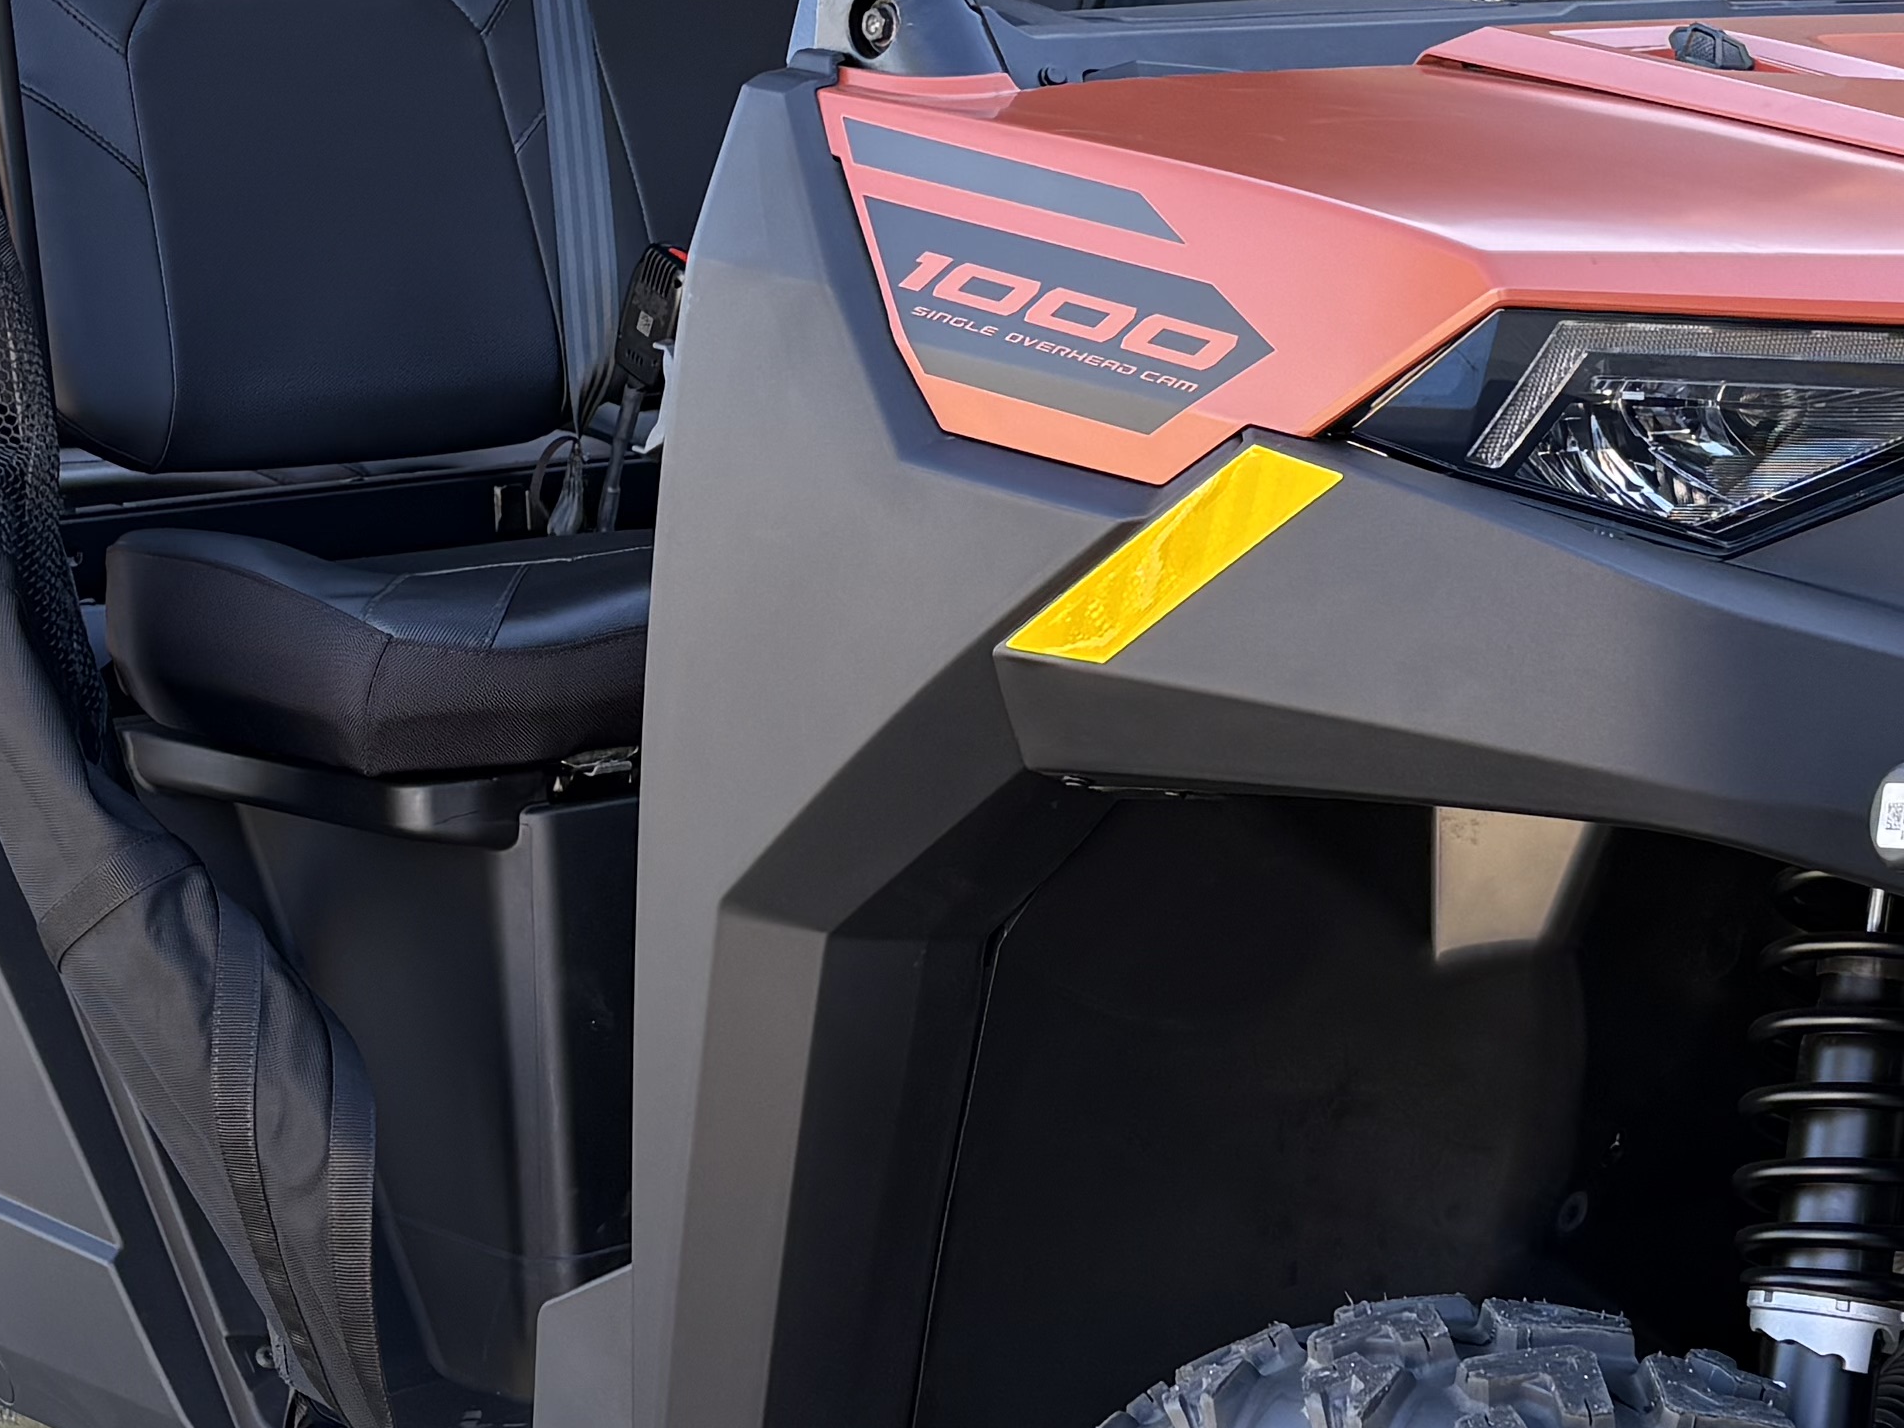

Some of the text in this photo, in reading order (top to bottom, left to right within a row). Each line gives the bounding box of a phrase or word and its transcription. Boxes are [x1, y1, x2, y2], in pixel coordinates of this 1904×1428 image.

[898, 251, 1240, 371] 1000
[910, 305, 1199, 394] SINGLE OVERHEAD CAM
